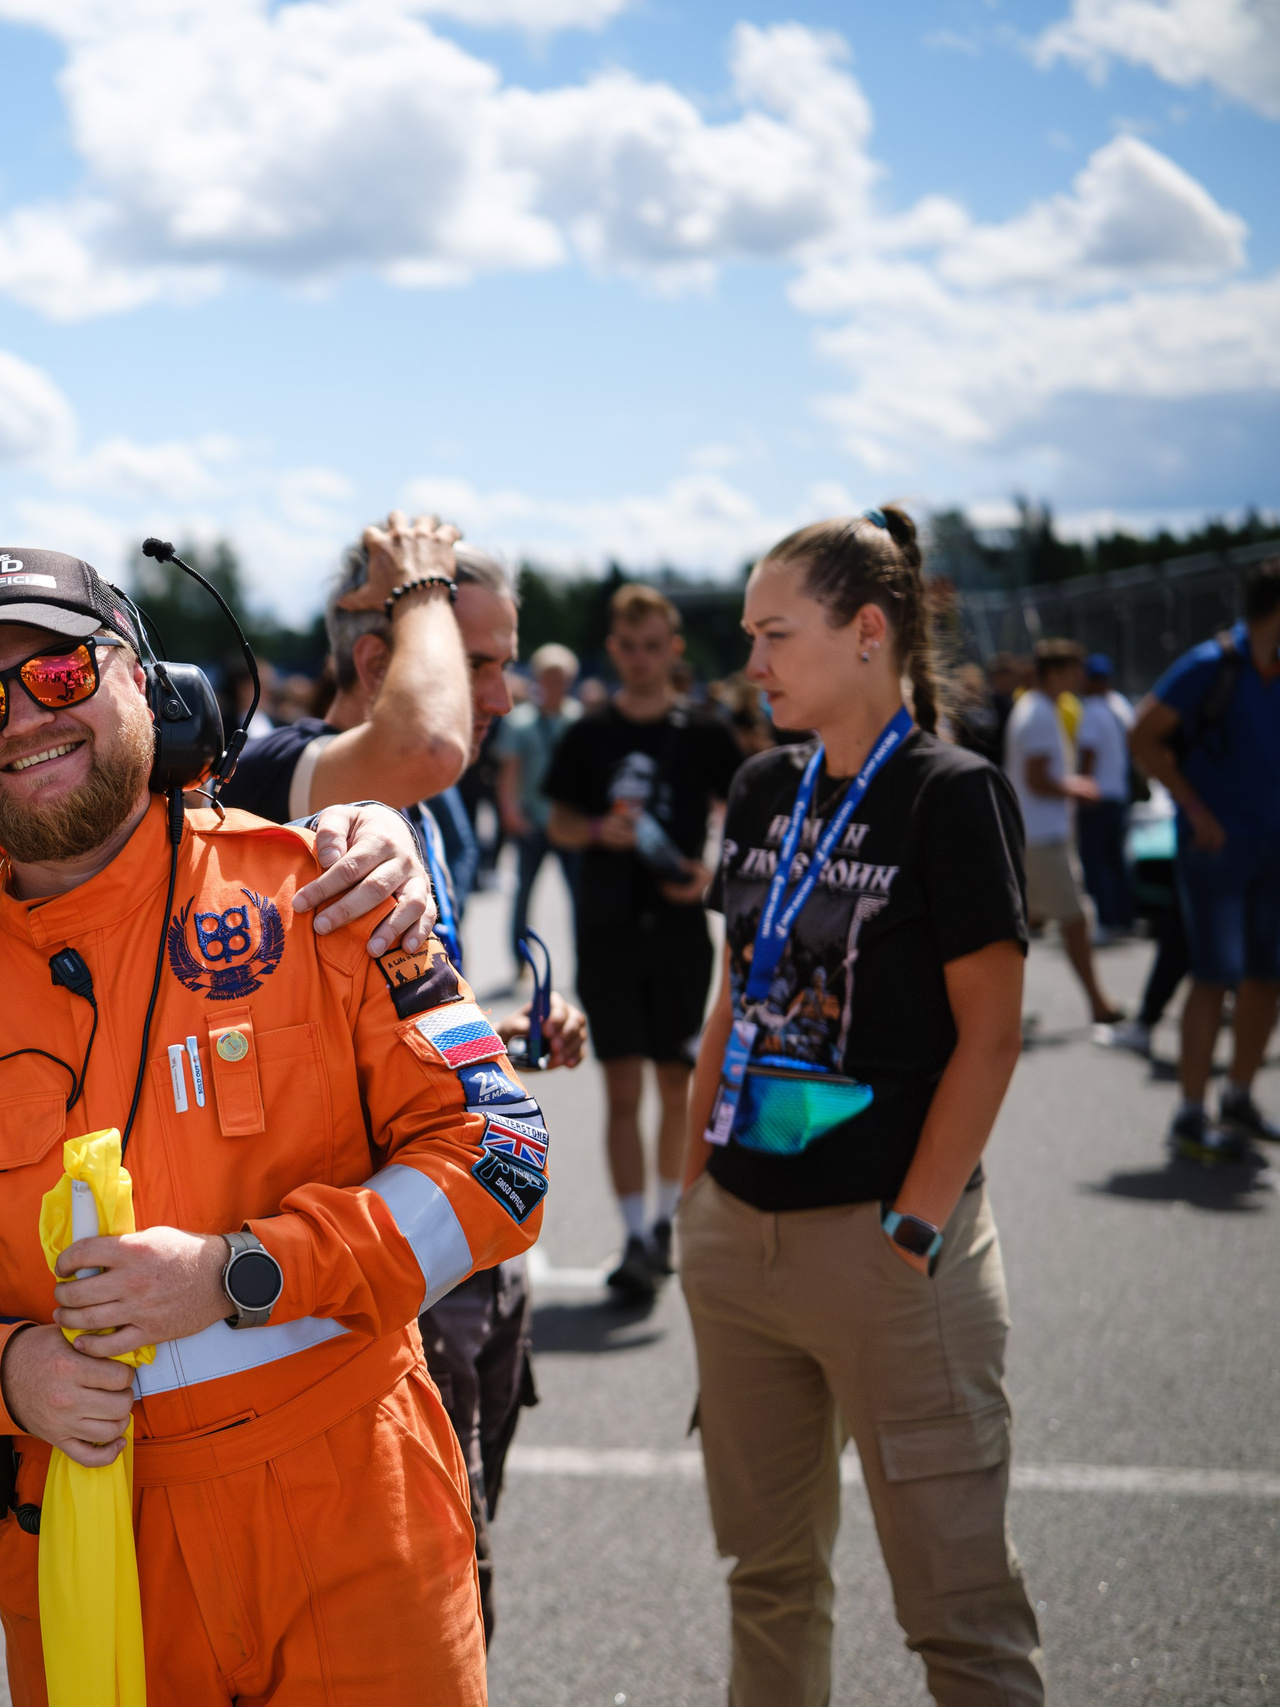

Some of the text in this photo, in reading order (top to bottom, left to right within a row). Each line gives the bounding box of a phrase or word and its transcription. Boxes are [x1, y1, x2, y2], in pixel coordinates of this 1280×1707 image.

[393, 955, 406, 966] Life
[478, 1086, 514, 1103] LE MANS
[489, 1113, 548, 1142] SILVERSTONE
[495, 1177, 512, 1195] EMSO
[509, 1191, 526, 1214] OFFICIAL
